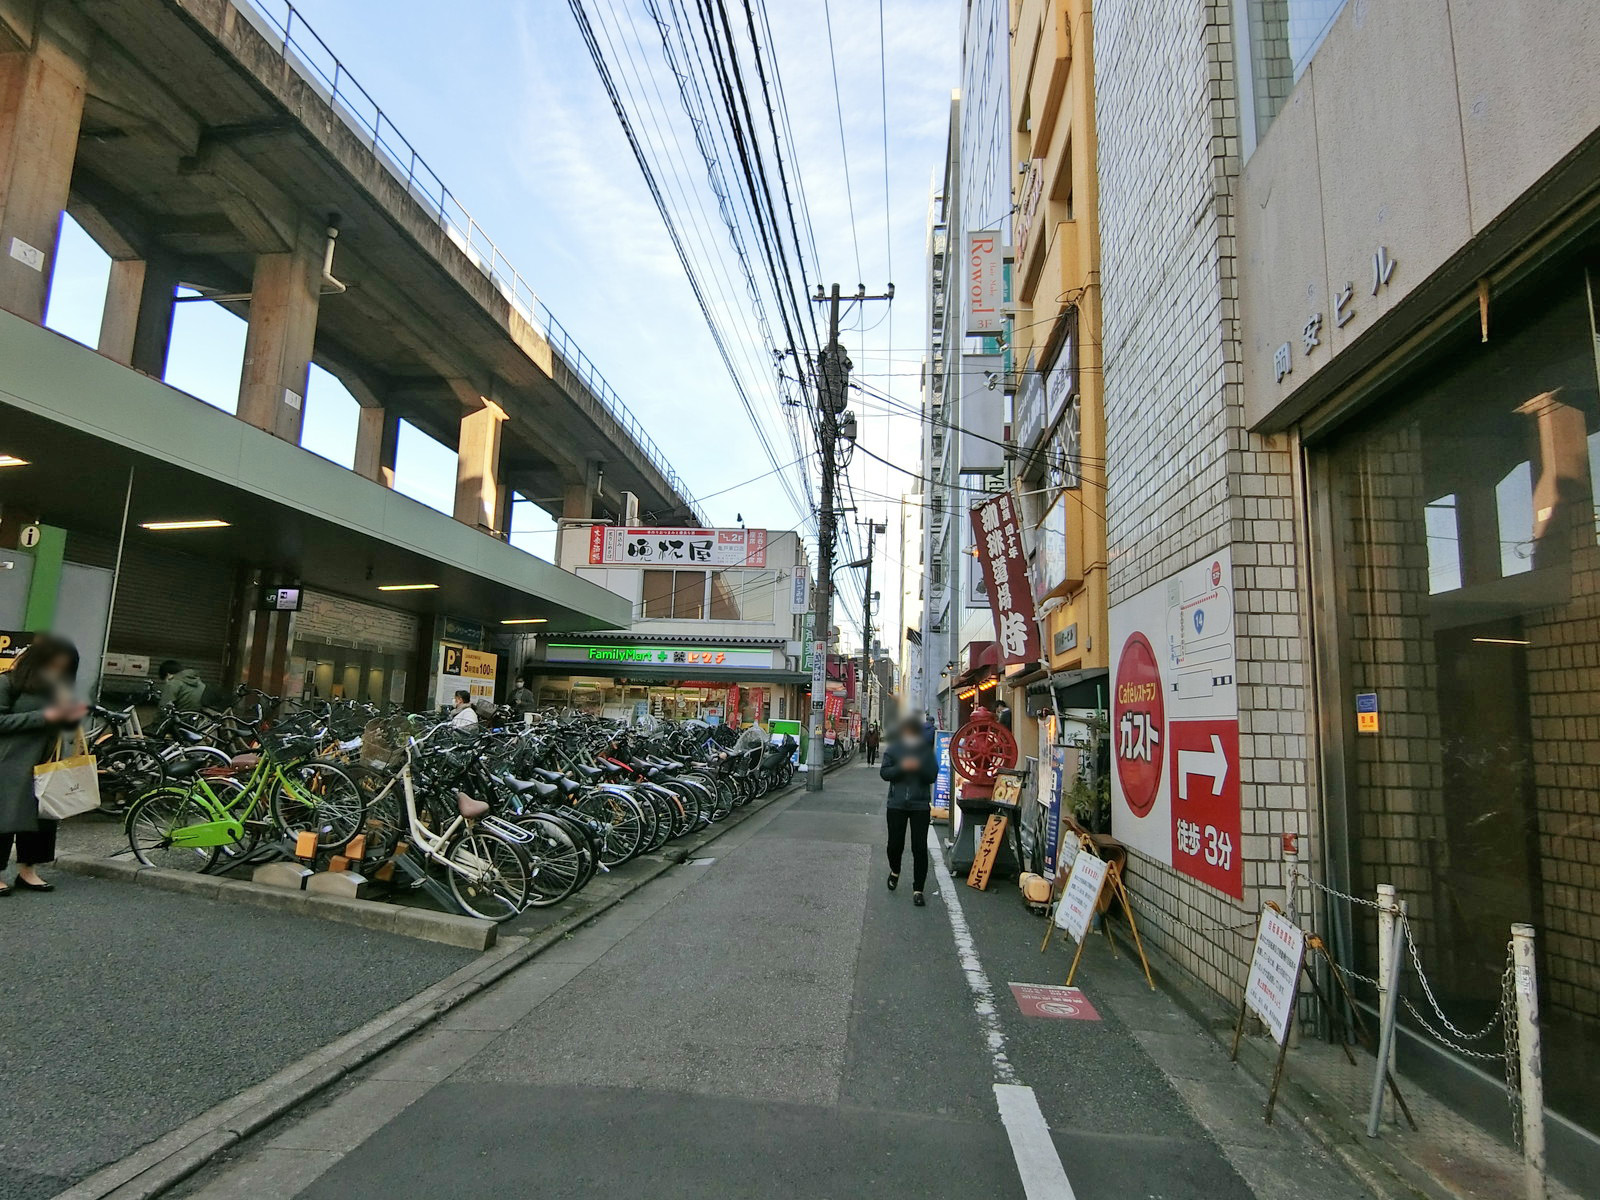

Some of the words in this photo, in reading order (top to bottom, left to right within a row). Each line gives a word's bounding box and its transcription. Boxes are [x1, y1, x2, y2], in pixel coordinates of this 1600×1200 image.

[977, 319, 993, 329] 3F
[731, 533, 744, 542] 2F
[1195, 613, 1203, 628] 14
[588, 648, 653, 662] FamilyMart
[1119, 710, 1160, 762] ガスト
[1176, 817, 1202, 852] 徒歩
[1203, 823, 1233, 871] 3分
[973, 816, 1002, 889] ランチサービス
